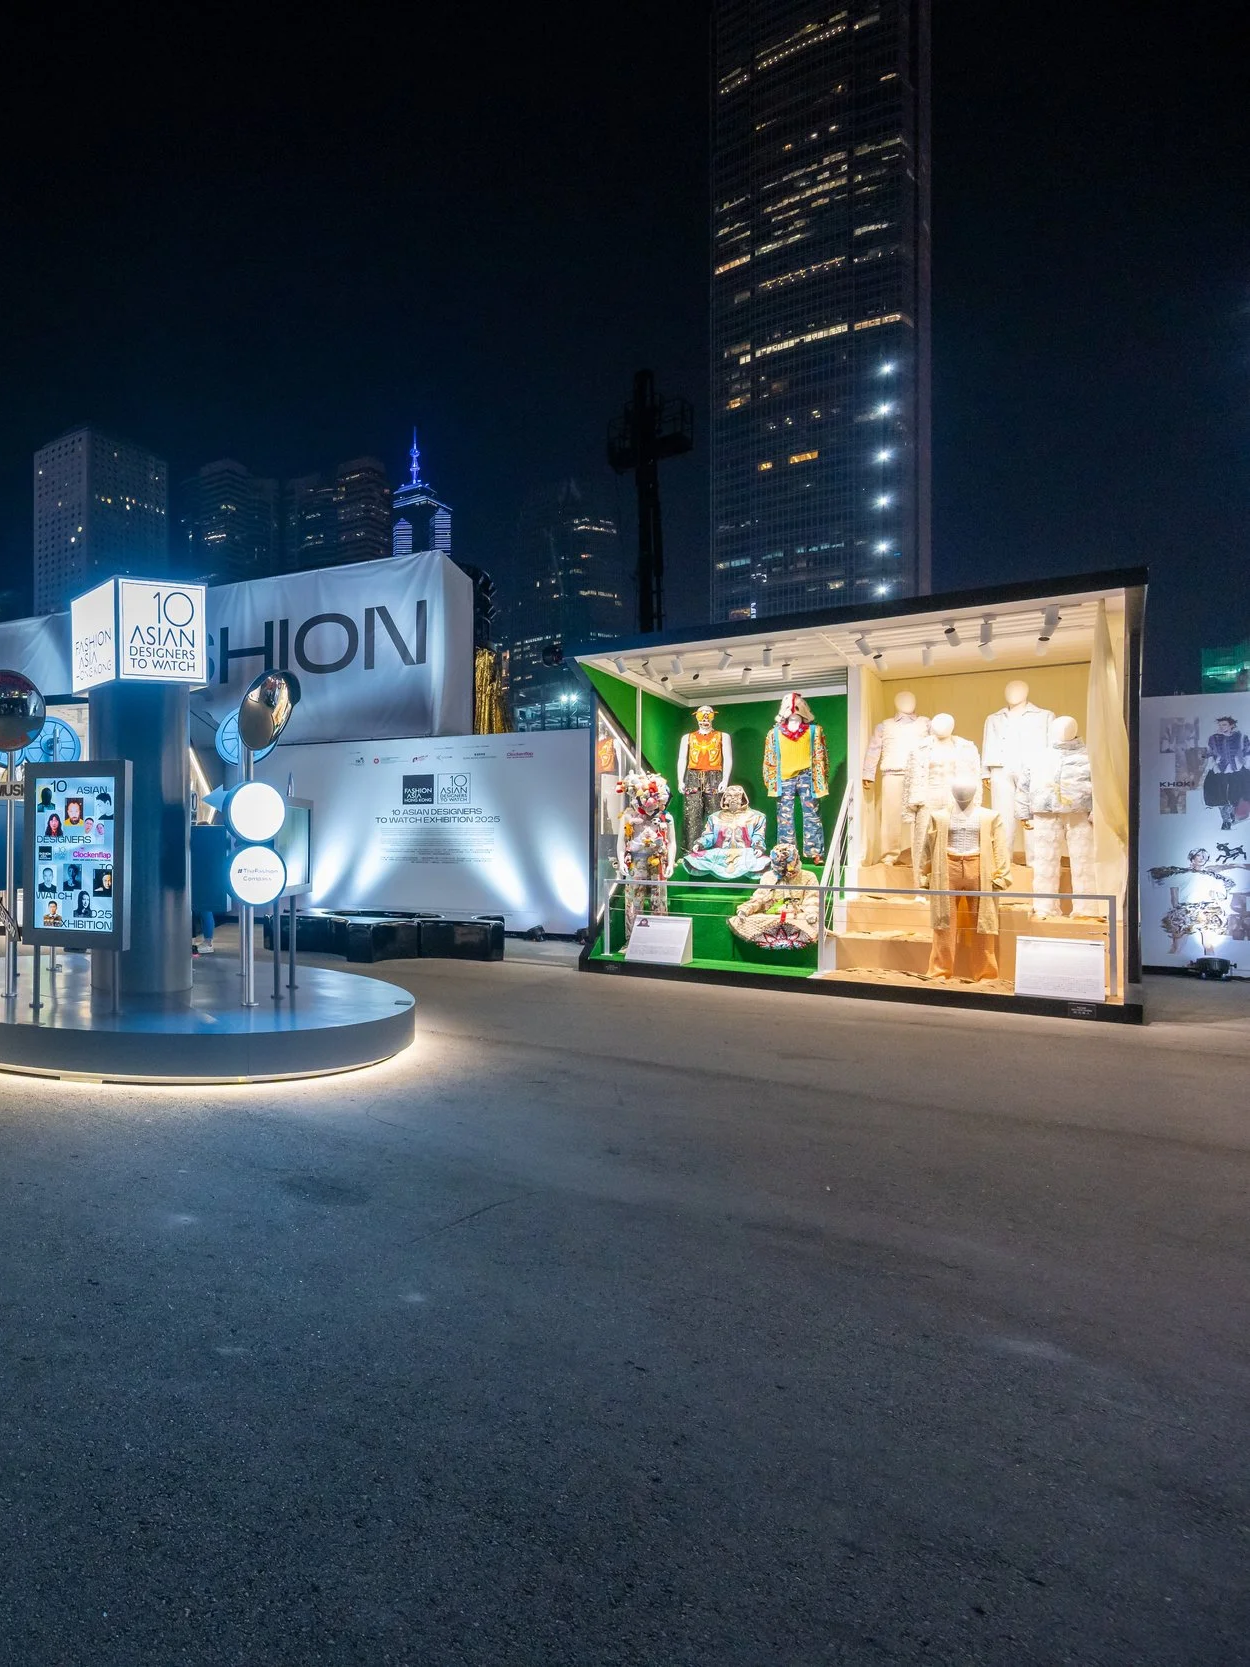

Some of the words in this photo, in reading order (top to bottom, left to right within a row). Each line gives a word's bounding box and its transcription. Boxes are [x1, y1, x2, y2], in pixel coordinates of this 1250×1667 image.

[153, 591, 194, 627] 10
[130, 625, 195, 648] ASIAN
[129, 646, 195, 660] DESIGNERS
[130, 658, 147, 669] TO
[152, 660, 195, 672] WATCH
[50, 780, 67, 793] 10
[450, 775, 467, 787] 10
[76, 786, 108, 794] ASIAN
[36, 836, 92, 844] DESIGNERS
[72, 850, 111, 860] Clockenflap
[36, 892, 72, 900] WATCH
[90, 910, 112, 919] 025
